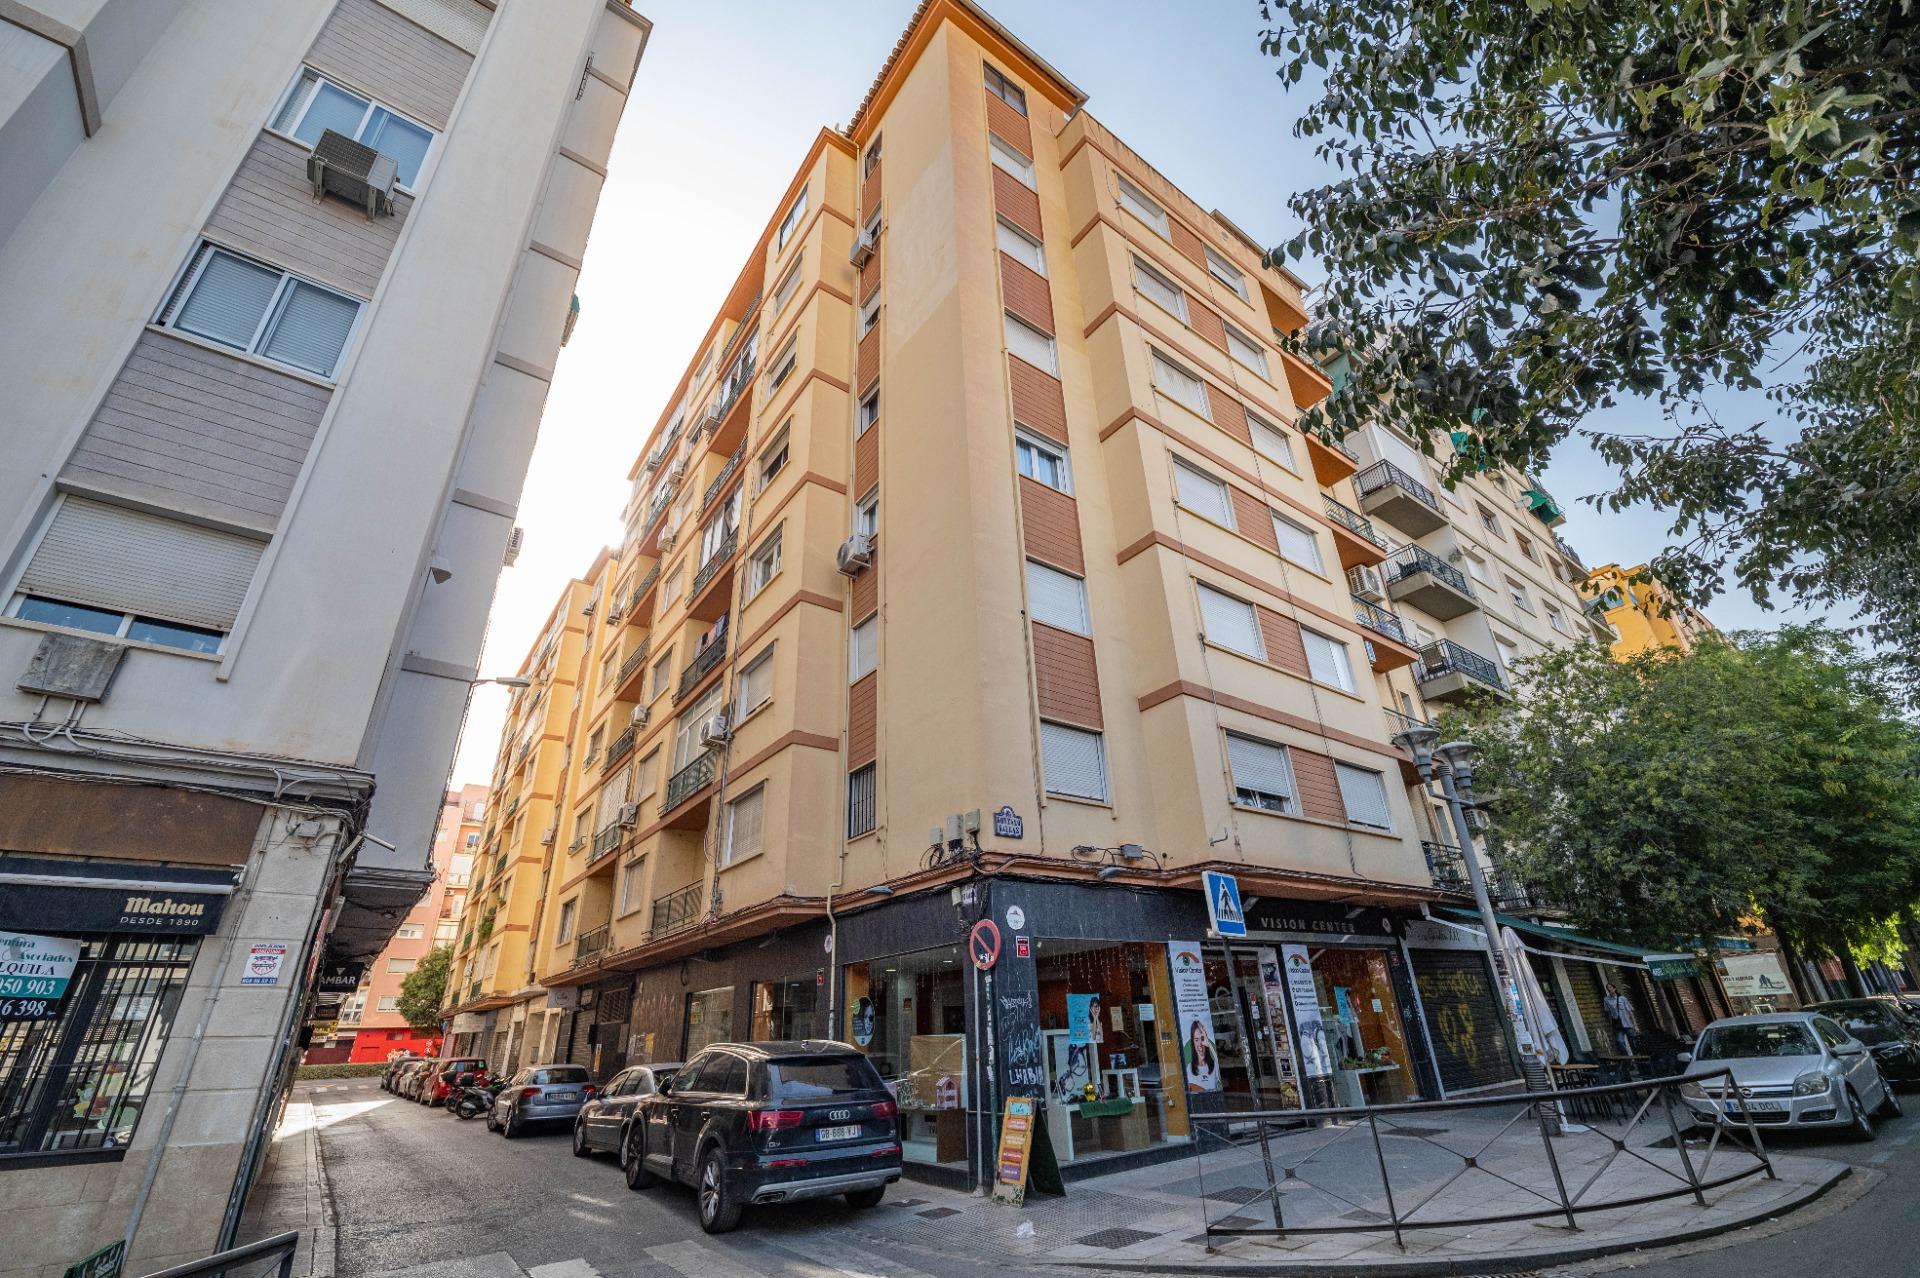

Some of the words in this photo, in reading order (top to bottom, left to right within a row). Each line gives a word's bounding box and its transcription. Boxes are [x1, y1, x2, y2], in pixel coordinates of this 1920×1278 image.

[124, 896, 204, 916] Mahou
[120, 916, 162, 925] DESDE
[169, 917, 199, 927] 1890
[1260, 917, 1306, 930] VISION
[1311, 920, 1355, 933] CENTER
[24, 979, 56, 995] 903
[14, 1000, 48, 1017] 398
